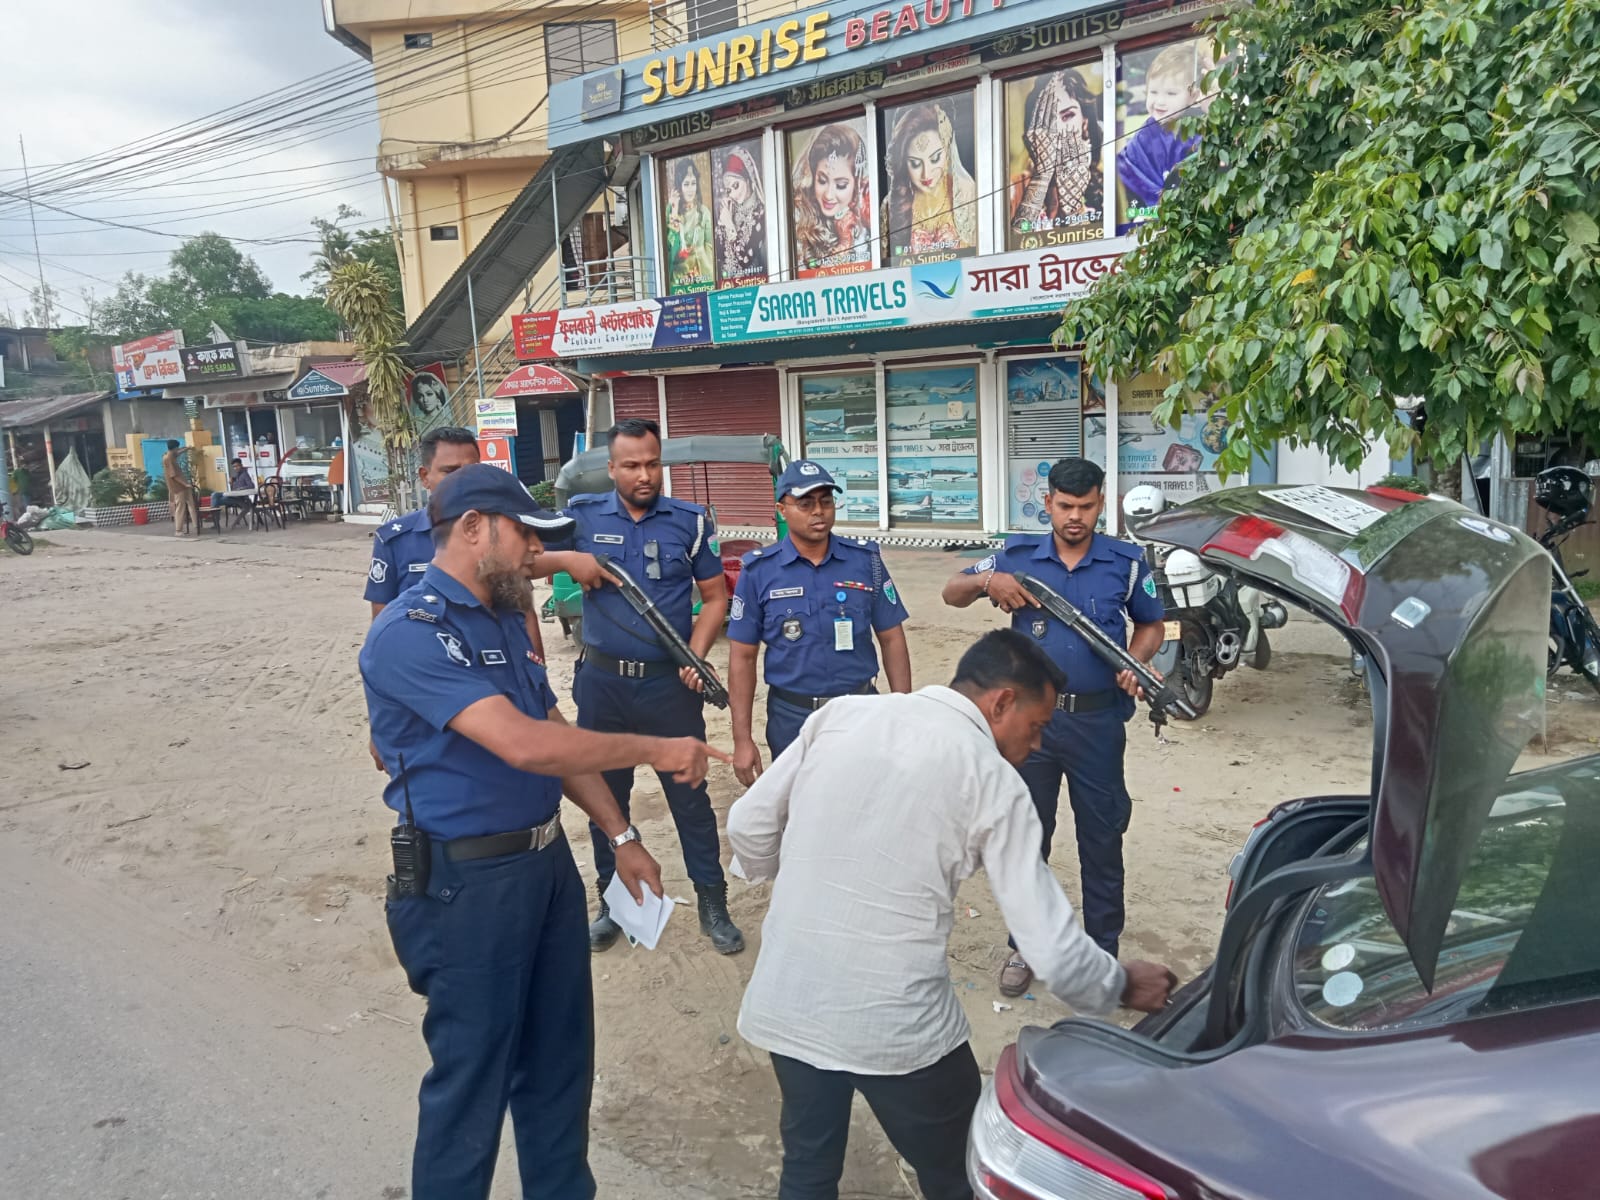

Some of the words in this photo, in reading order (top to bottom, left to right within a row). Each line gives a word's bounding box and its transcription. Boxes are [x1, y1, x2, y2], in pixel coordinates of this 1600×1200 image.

[1023, 9, 1120, 52] Sunrise
[641, 11, 829, 105] SUNRISE
[845, 0, 1002, 48] BEAU
[808, 70, 885, 99] সানরাইজ
[649, 110, 711, 142] Sunrise
[1047, 227, 1104, 245] Sunrise
[917, 252, 957, 264] Sunrise
[735, 276, 767, 288] Sunrise
[830, 265, 866, 276] Sunrise
[968, 264, 1030, 293] সারা
[687, 285, 715, 294] Sunrise
[758, 290, 817, 322] SARAA
[821, 279, 907, 316] TRAVELS
[559, 309, 597, 344] ফুলবাড়ী
[304, 384, 330, 394] Sunrise
[1163, 480, 1194, 491] TRAVELS
